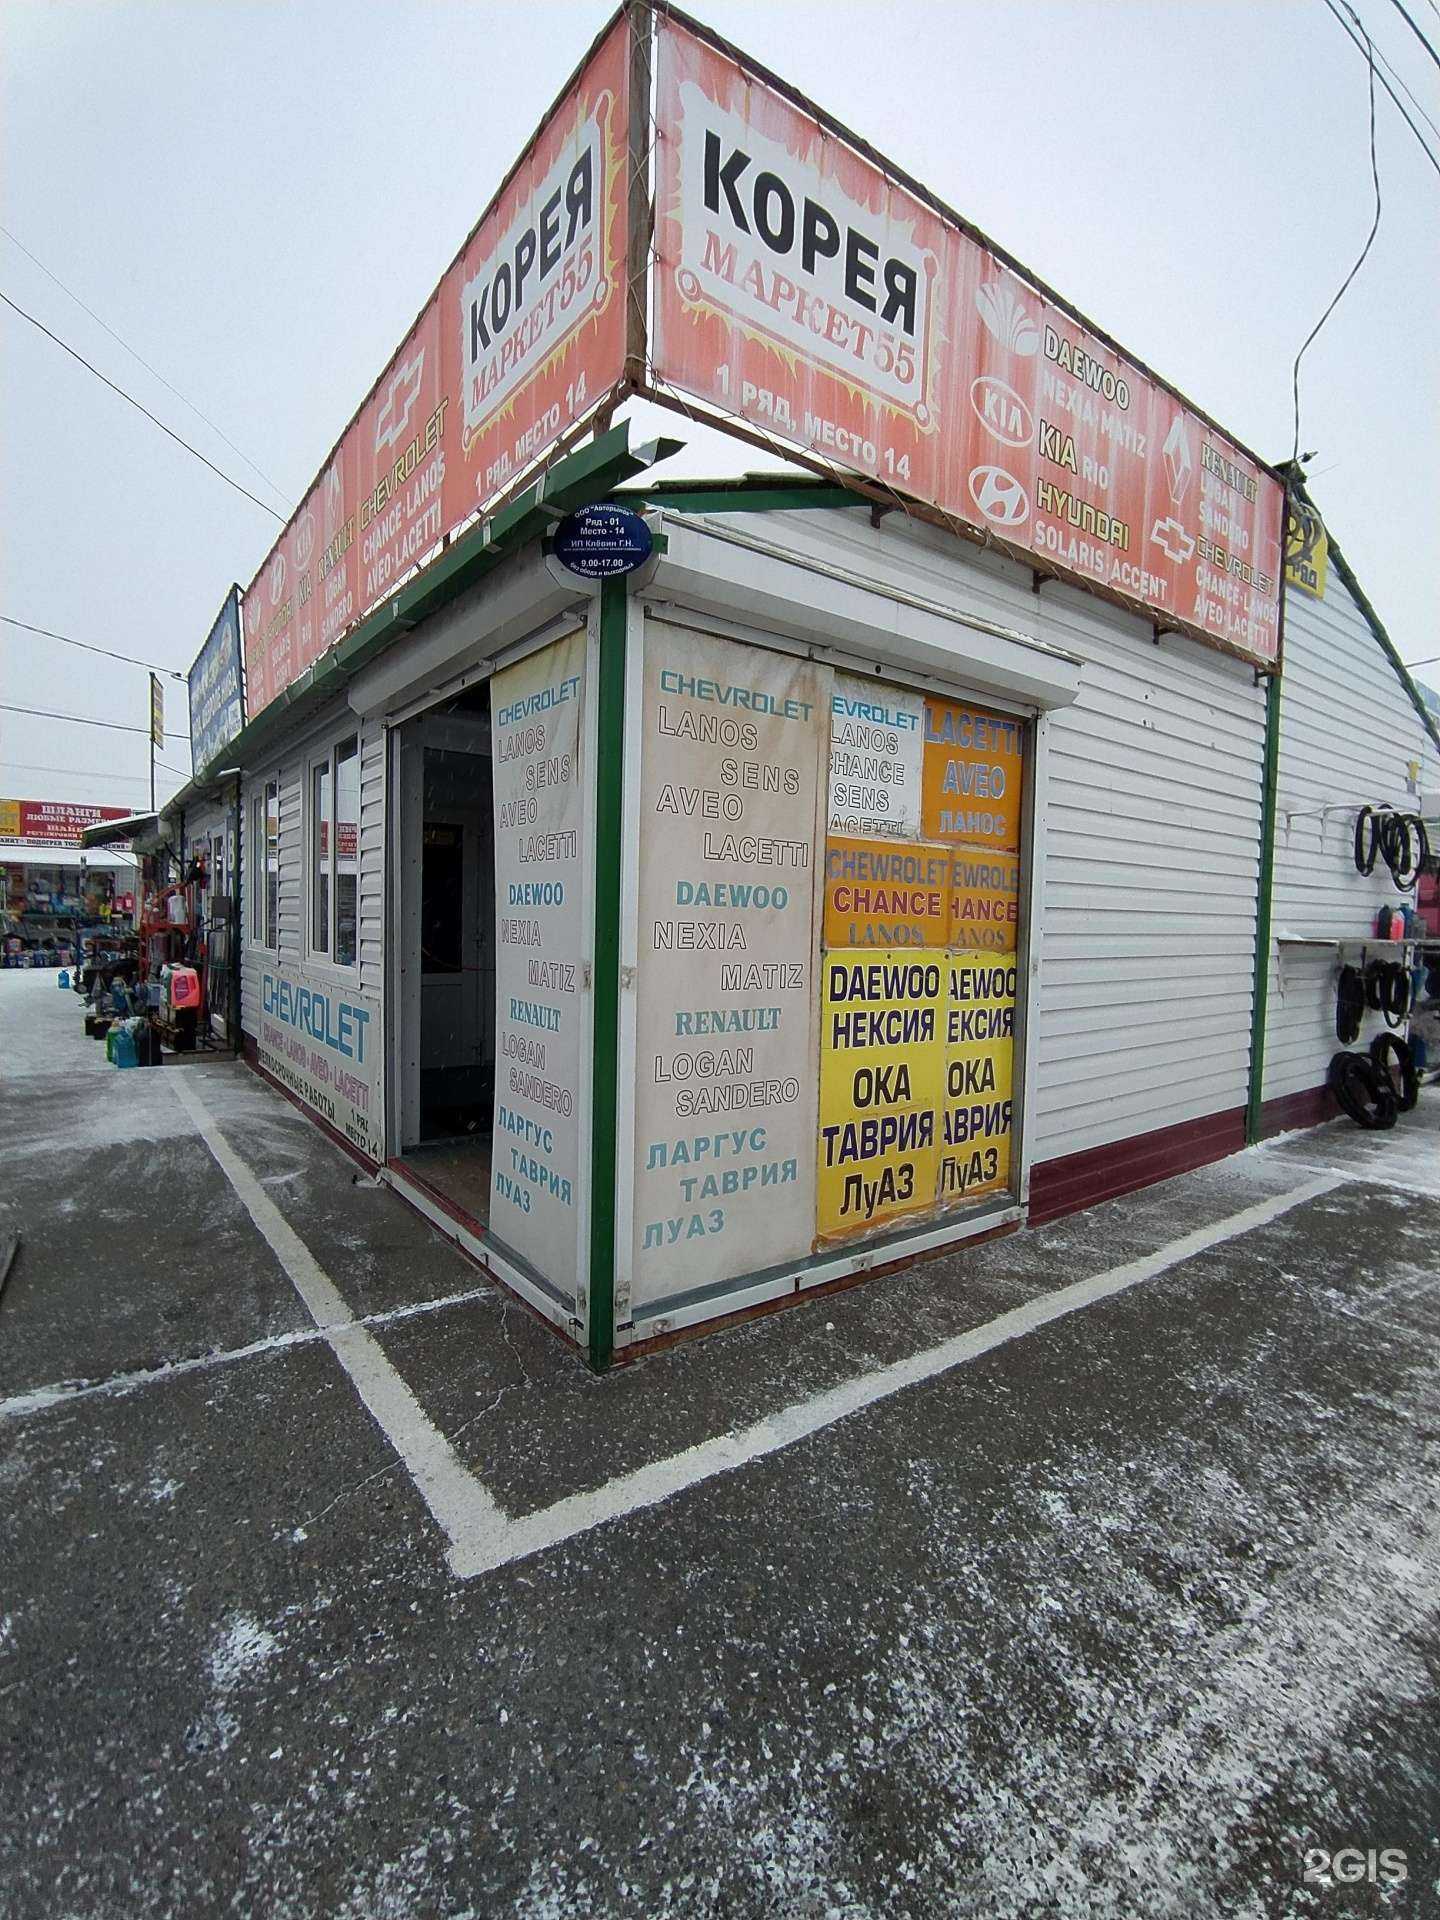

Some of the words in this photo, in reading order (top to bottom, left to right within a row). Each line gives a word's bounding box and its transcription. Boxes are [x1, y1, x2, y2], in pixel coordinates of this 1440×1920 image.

[704, 128, 918, 337] КОРЕЯ
[470, 144, 592, 365] КОРЕЯ
[471, 230, 594, 409] МАРКЕТ55
[700, 230, 916, 385] МАРКЕТ55
[1044, 324, 1131, 411] DAEWOO
[716, 363, 729, 396] 1
[741, 381, 797, 433] РЯД,
[804, 411, 877, 465] МЕСТО
[884, 447, 911, 481] 14
[984, 387, 1025, 440] KIA
[475, 472, 482, 498] 1
[514, 408, 560, 463] МЕСТО
[565, 370, 587, 416] 14
[360, 397, 448, 532] CHEVROLET
[1039, 418, 1078, 475] KIA
[1082, 455, 1109, 491] RIO
[1201, 441, 1258, 504] RENAULT
[574, 508, 590, 518] ООО
[580, 527, 607, 535] Место
[615, 527, 624, 535] 14
[585, 518, 602, 527] Ряд
[609, 517, 620, 526] 01
[1037, 477, 1130, 553] HYUNDAI
[571, 540, 583, 548] ИП
[581, 559, 624, 567] 9.00-17.00
[1035, 520, 1104, 573] SOLARIS
[1111, 558, 1168, 601] ACCENT
[1197, 535, 1275, 597] CHEVROLET
[499, 675, 580, 727] CHEVROLET
[660, 670, 814, 722] CHEVROLET
[832, 696, 919, 731] EVROLET
[498, 724, 545, 763] LANOS
[658, 706, 758, 750] LANOS
[831, 719, 899, 755] LANOS
[925, 707, 1023, 756] LACETTI
[526, 754, 570, 791] SENS
[721, 758, 800, 795] SENS
[943, 760, 1006, 799] AVEO
[499, 797, 538, 829] AVEO
[656, 785, 743, 821] AVEO
[834, 783, 889, 812] SENS
[940, 810, 1006, 837] ЛАНОС
[519, 830, 577, 863] LACETTI
[703, 832, 809, 867] LACETTI
[509, 881, 563, 906] DAEWOO
[676, 880, 788, 910] DAEWOO
[833, 885, 942, 918] CHANCE
[501, 919, 541, 947] NEXIA
[653, 921, 747, 950] NEXIA
[849, 922, 925, 946] LANOS
[528, 959, 576, 993] MATIZ
[721, 964, 803, 991] MATIZ
[829, 964, 940, 1002] DAEWOO
[263, 974, 370, 1065] CHEVROLET
[509, 998, 562, 1033] RENAULT
[675, 1007, 781, 1036] RENAULT
[832, 1008, 935, 1049] НЕКСИЯ
[502, 1032, 545, 1070] LOGAN
[654, 1048, 753, 1082] LOGAN
[304, 1081, 336, 1122] РАБОТЫ
[510, 1067, 573, 1117] SANDERO
[675, 1077, 800, 1117] SANDERO
[853, 1063, 911, 1109] ОКА
[947, 1057, 995, 1098] ОКА
[345, 1122, 366, 1149] МЕСТО
[368, 1139, 378, 1158] 14
[499, 1104, 553, 1154] ЛАРГУС
[646, 1127, 767, 1170] ЛАРГУС
[822, 1111, 934, 1167] ТАВРИЯ
[495, 1172, 531, 1215] ЛУАЗ
[510, 1147, 572, 1205] ТАВРИЯ
[680, 1159, 797, 1202] ТАВРИЯ
[642, 1209, 725, 1250] ЛУАЗ
